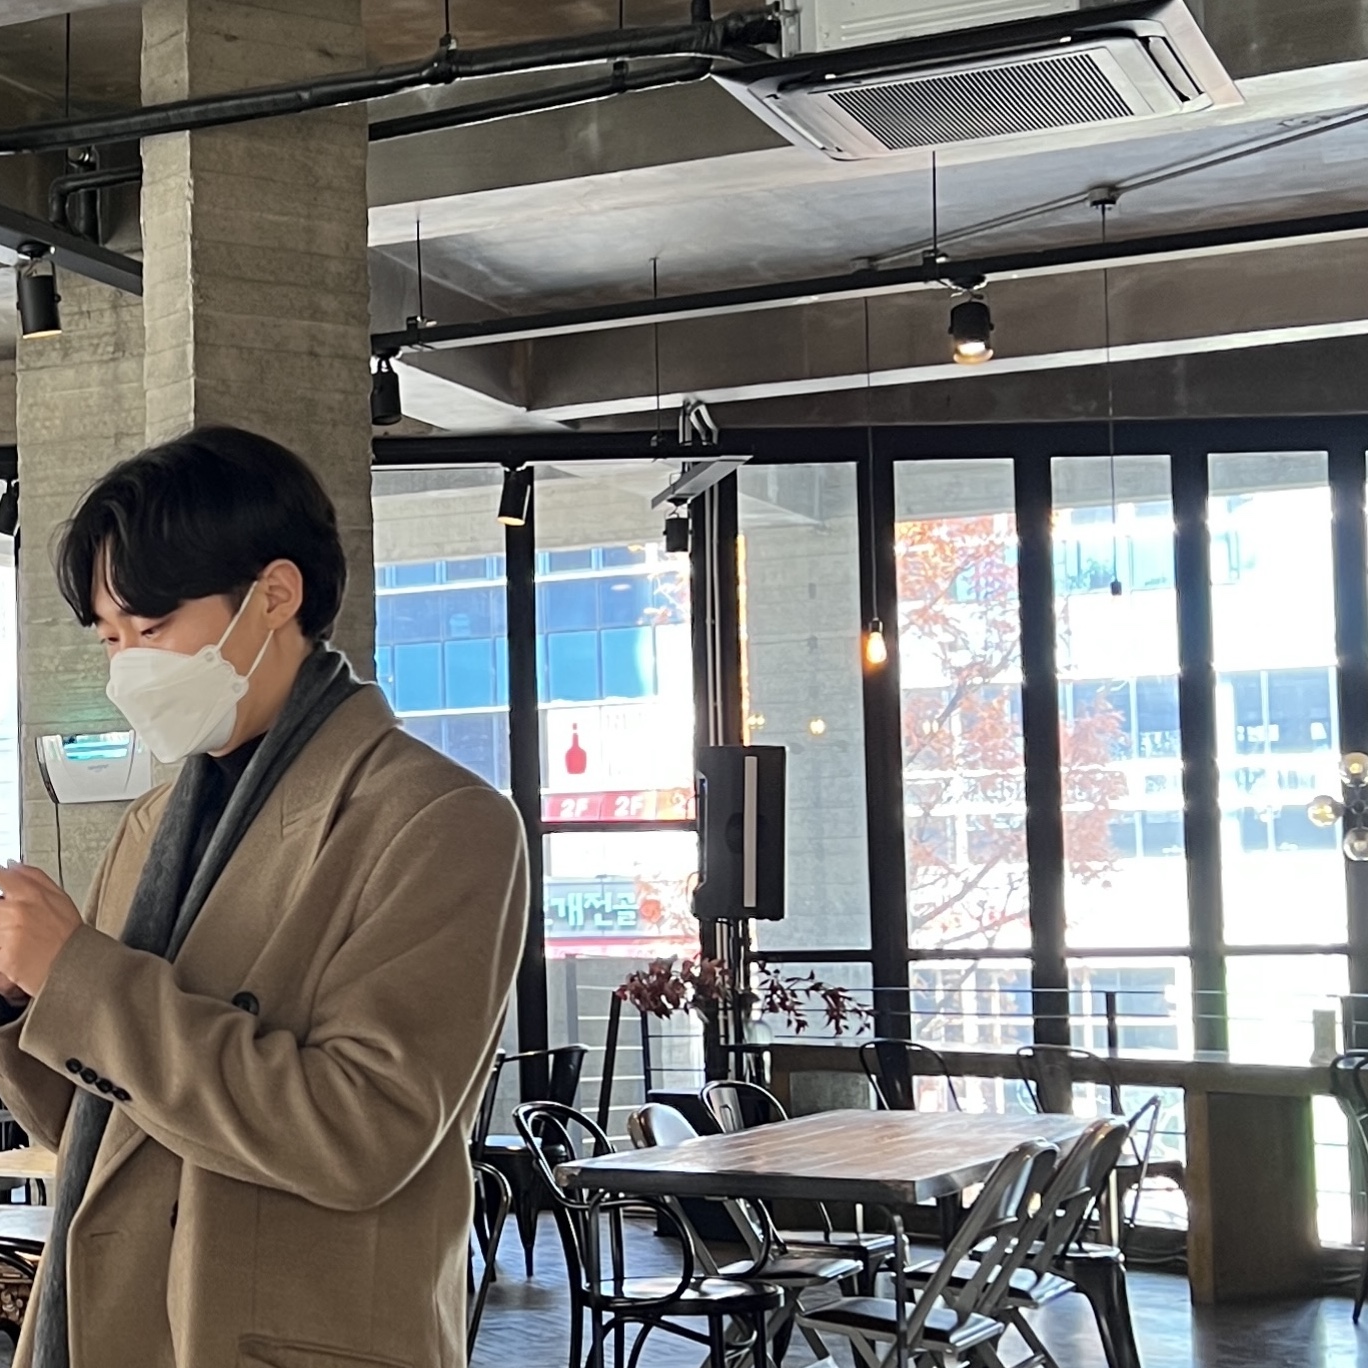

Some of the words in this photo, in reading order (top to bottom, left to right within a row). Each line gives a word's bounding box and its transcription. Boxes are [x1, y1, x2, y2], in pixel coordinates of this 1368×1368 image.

[560, 798, 589, 818] 2F
[614, 796, 643, 817] 2F
[544, 892, 639, 927] 개전골
